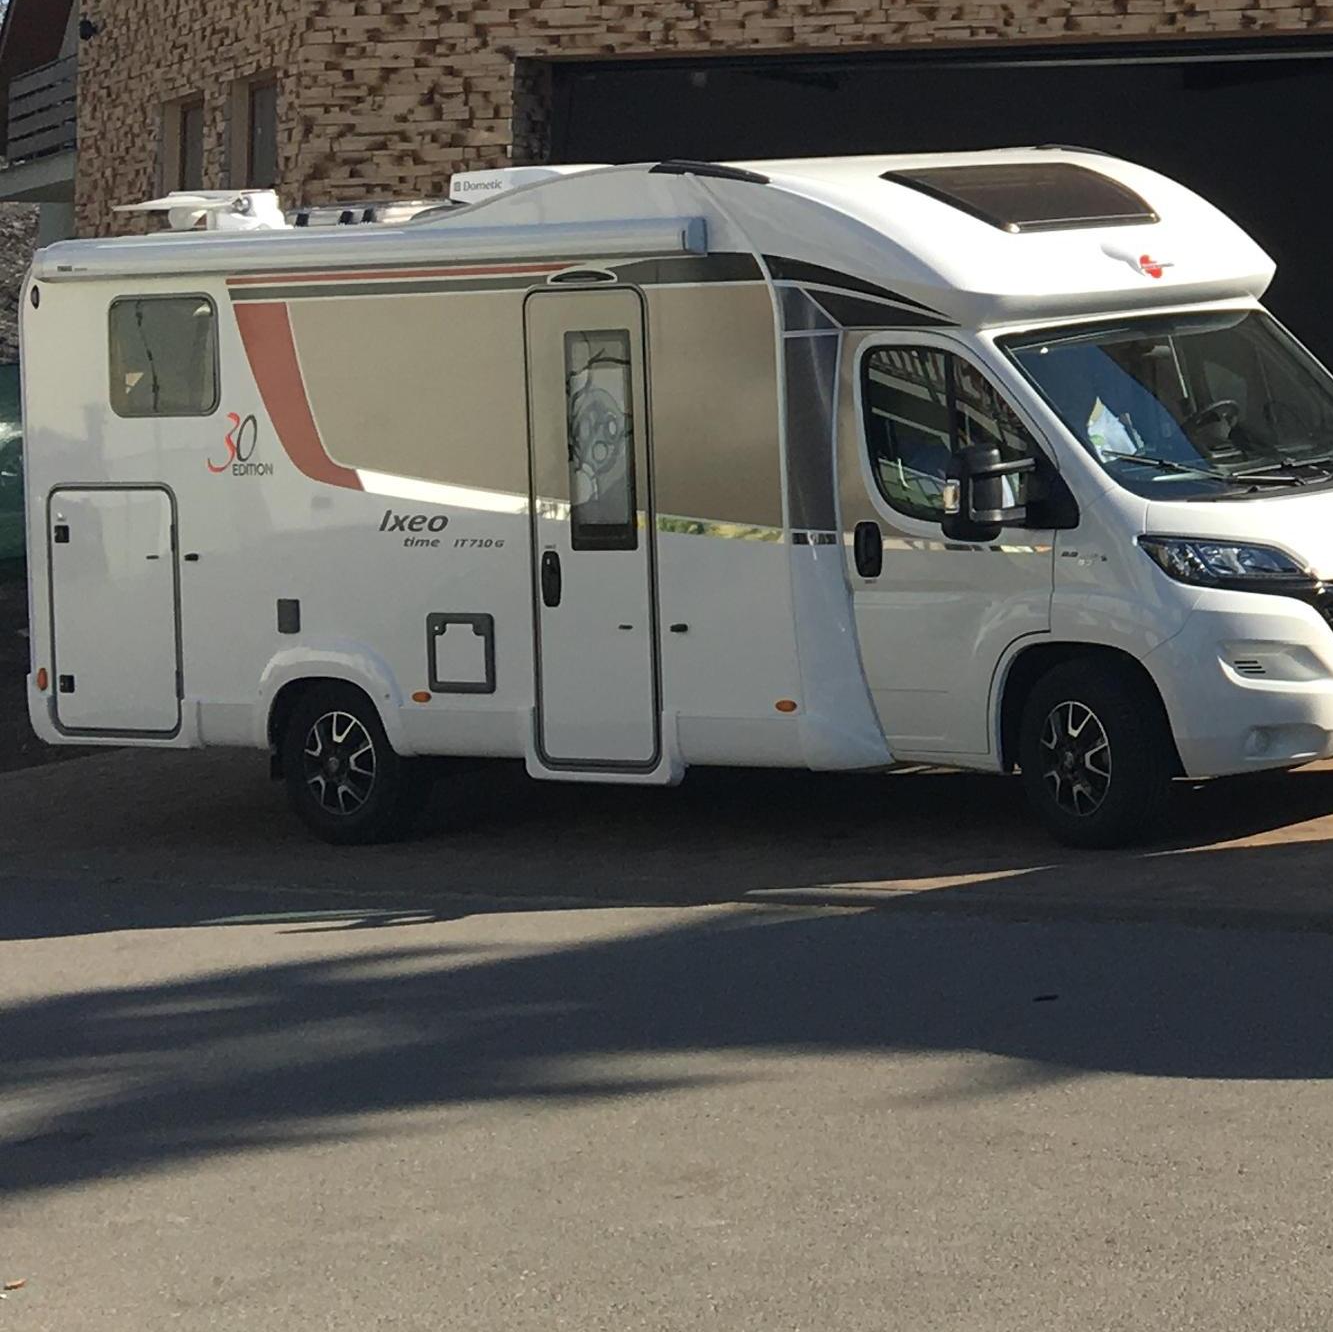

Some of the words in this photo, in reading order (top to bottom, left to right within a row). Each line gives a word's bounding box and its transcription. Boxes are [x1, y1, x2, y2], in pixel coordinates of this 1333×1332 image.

[463, 179, 502, 191] Dometic
[207, 411, 258, 472] 30
[232, 462, 273, 477] EDITION
[379, 509, 449, 533] Ixeo
[403, 536, 441, 548] time
